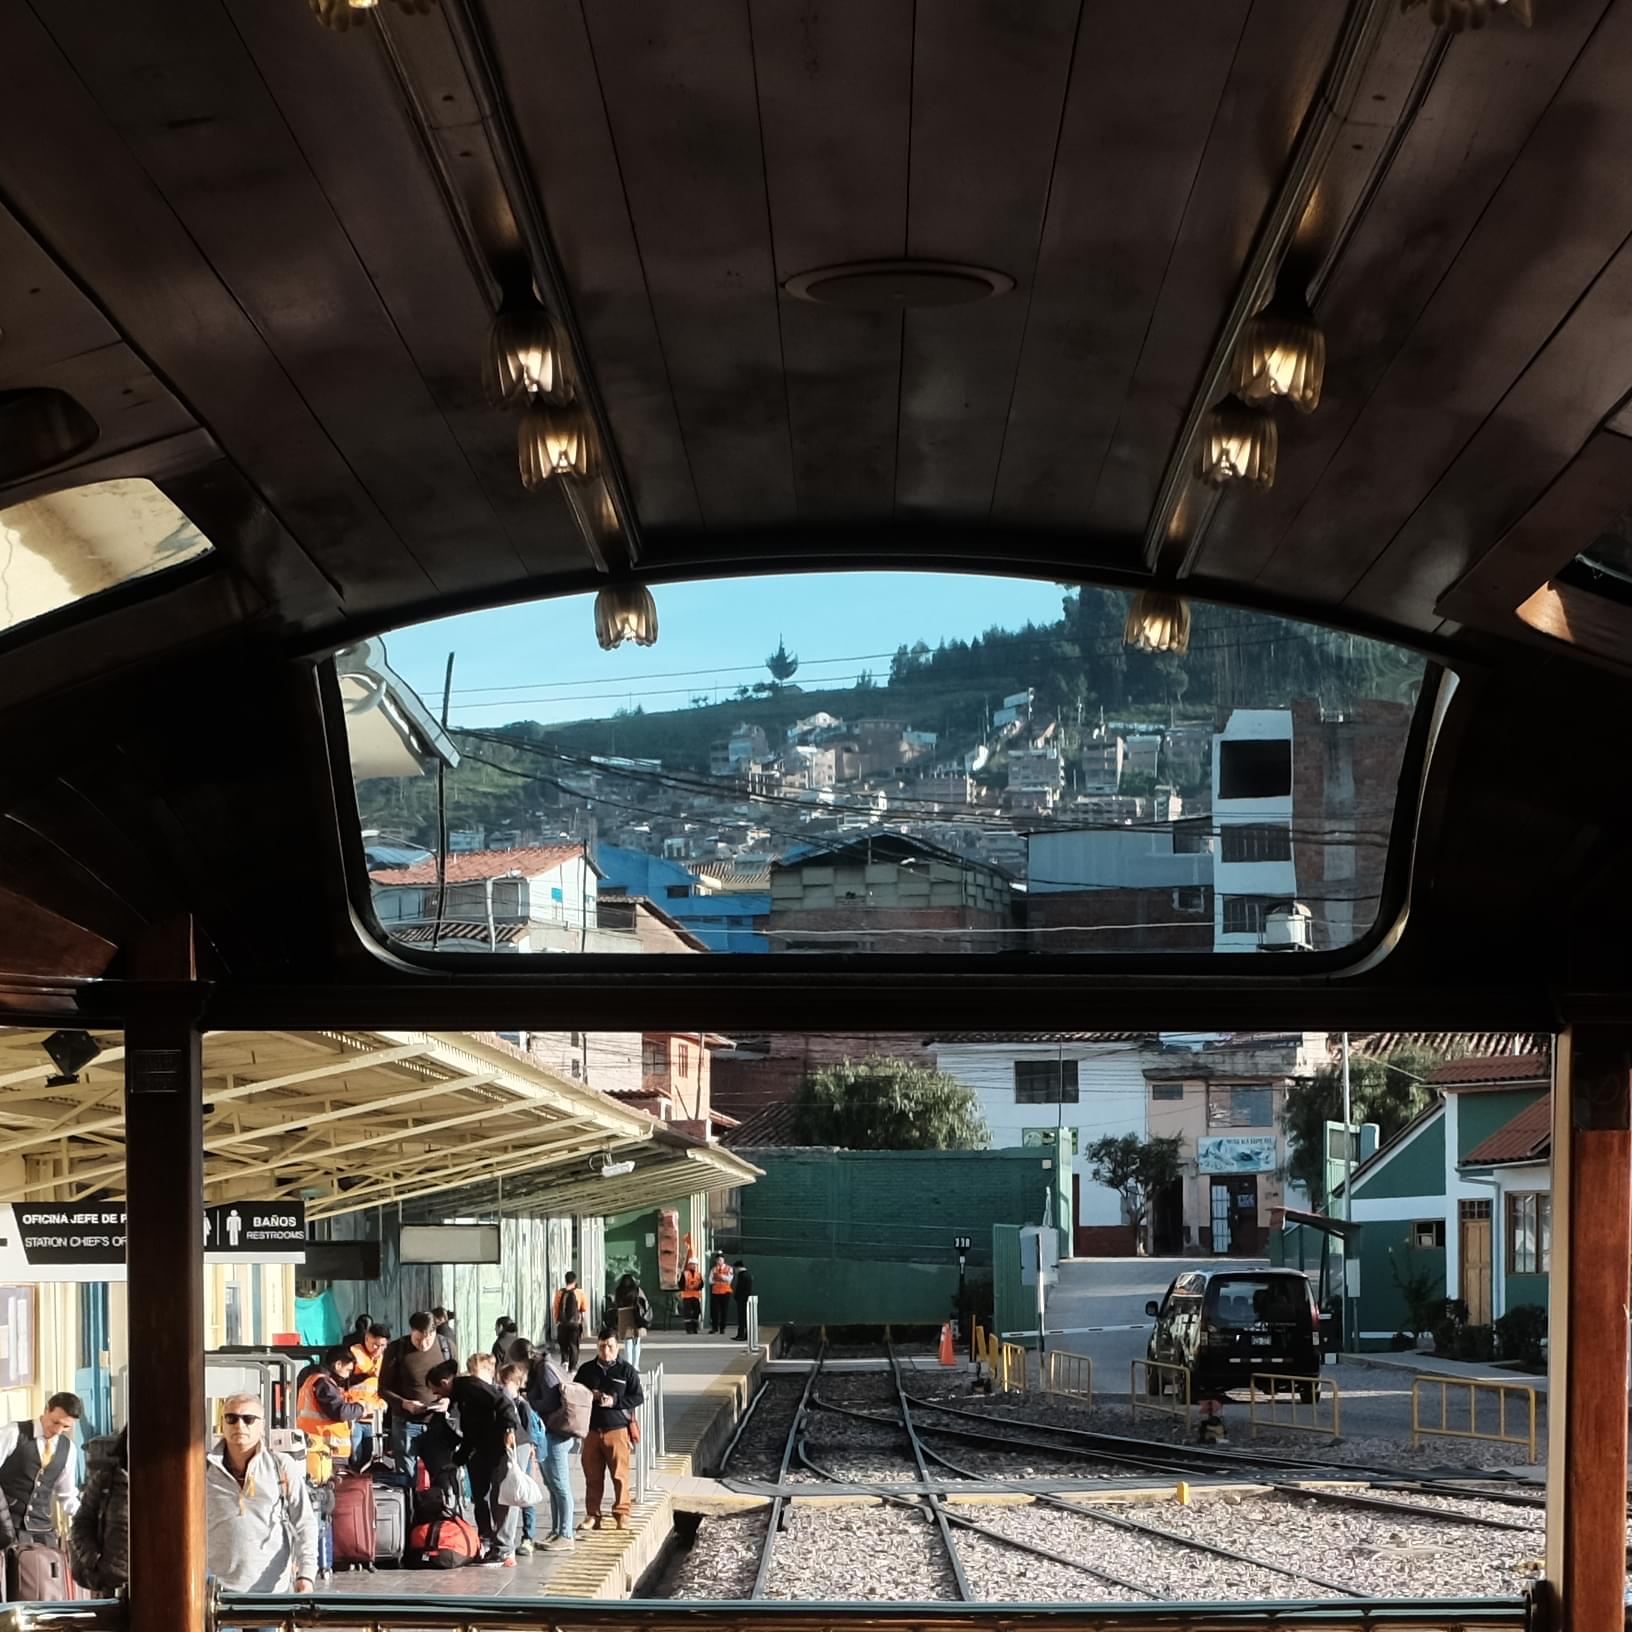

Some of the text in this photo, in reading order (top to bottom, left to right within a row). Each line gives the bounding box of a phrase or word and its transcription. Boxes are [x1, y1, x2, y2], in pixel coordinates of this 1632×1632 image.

[22, 1213, 69, 1224] OFICINA
[70, 1213, 99, 1224] JEFE
[101, 1213, 118, 1224] DE
[253, 1214, 296, 1227] BAÑOS
[246, 1231, 305, 1240] RESTROOMS
[24, 1236, 67, 1247] STATION
